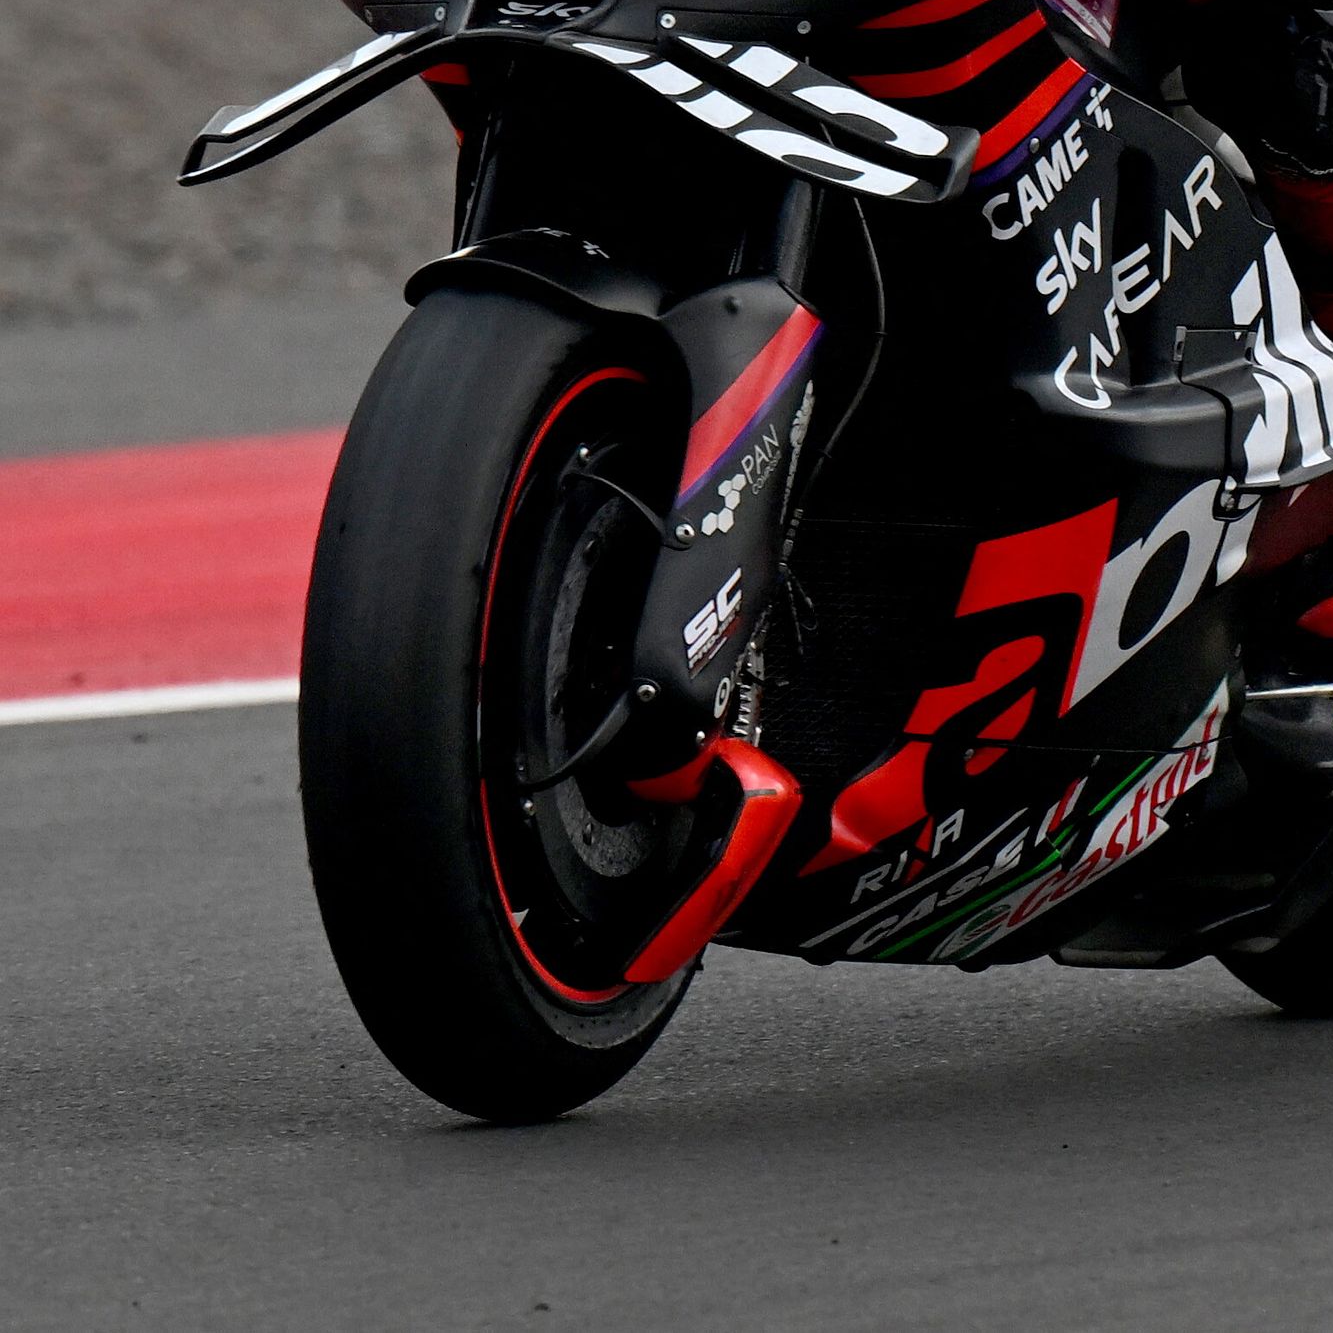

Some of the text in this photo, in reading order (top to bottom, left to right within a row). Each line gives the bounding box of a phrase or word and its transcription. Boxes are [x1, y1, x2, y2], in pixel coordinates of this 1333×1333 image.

[982, 119, 1089, 241] CAME
[741, 423, 780, 485] PAN
[683, 567, 742, 659] SC
